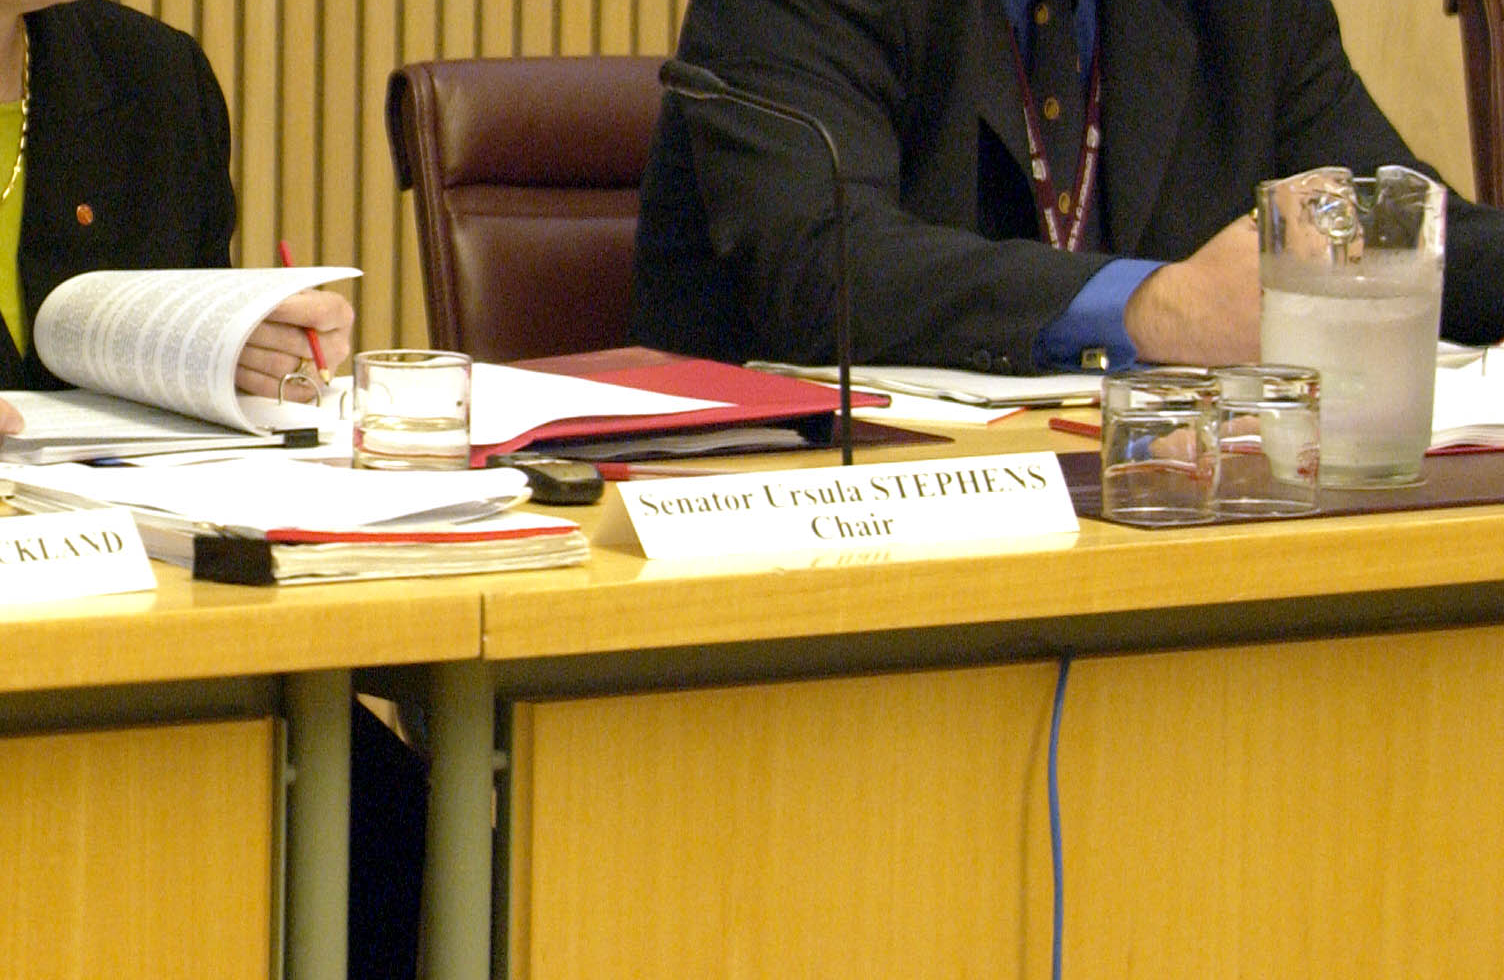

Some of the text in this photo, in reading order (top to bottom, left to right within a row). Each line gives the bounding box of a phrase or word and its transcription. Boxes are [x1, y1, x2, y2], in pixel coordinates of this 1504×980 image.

[638, 465, 1047, 517] Senator Ursula STEPHENS
[811, 512, 894, 539] Chair
